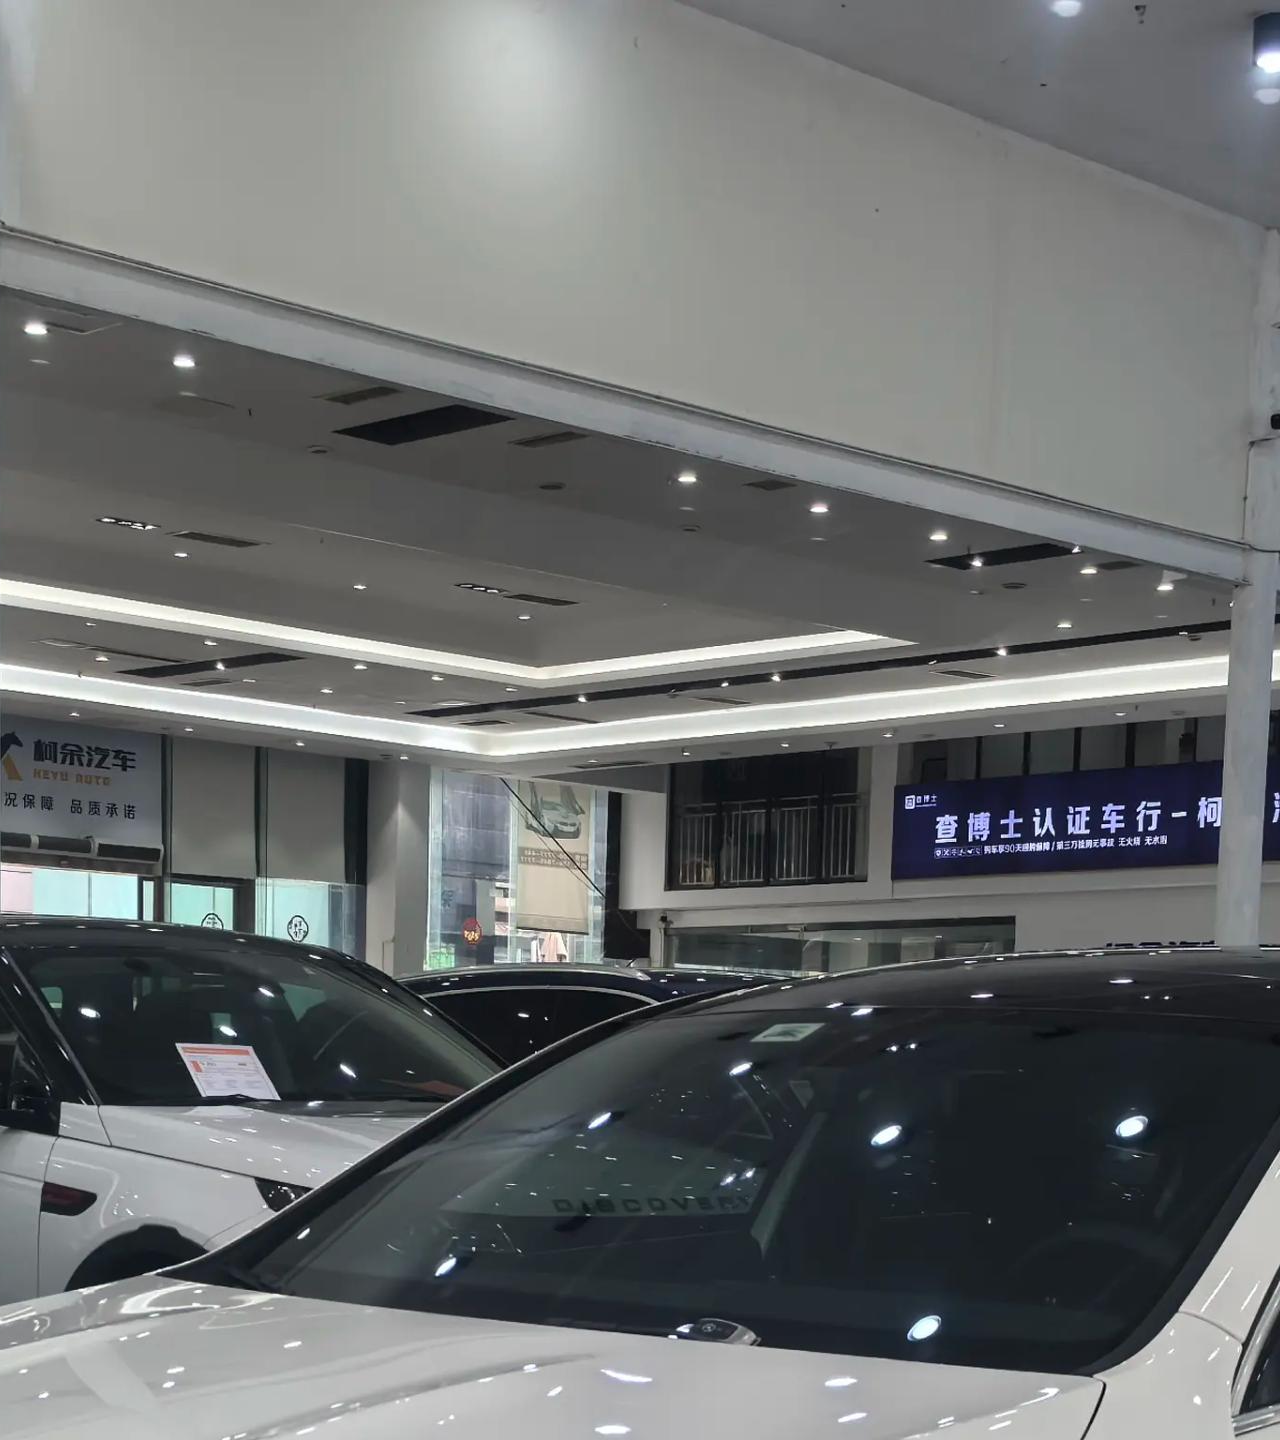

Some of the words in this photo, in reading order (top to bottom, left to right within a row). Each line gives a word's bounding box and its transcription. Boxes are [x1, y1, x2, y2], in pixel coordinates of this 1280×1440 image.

[33, 738, 137, 772] 柯余汽车
[70, 800, 136, 820] 品质承诺
